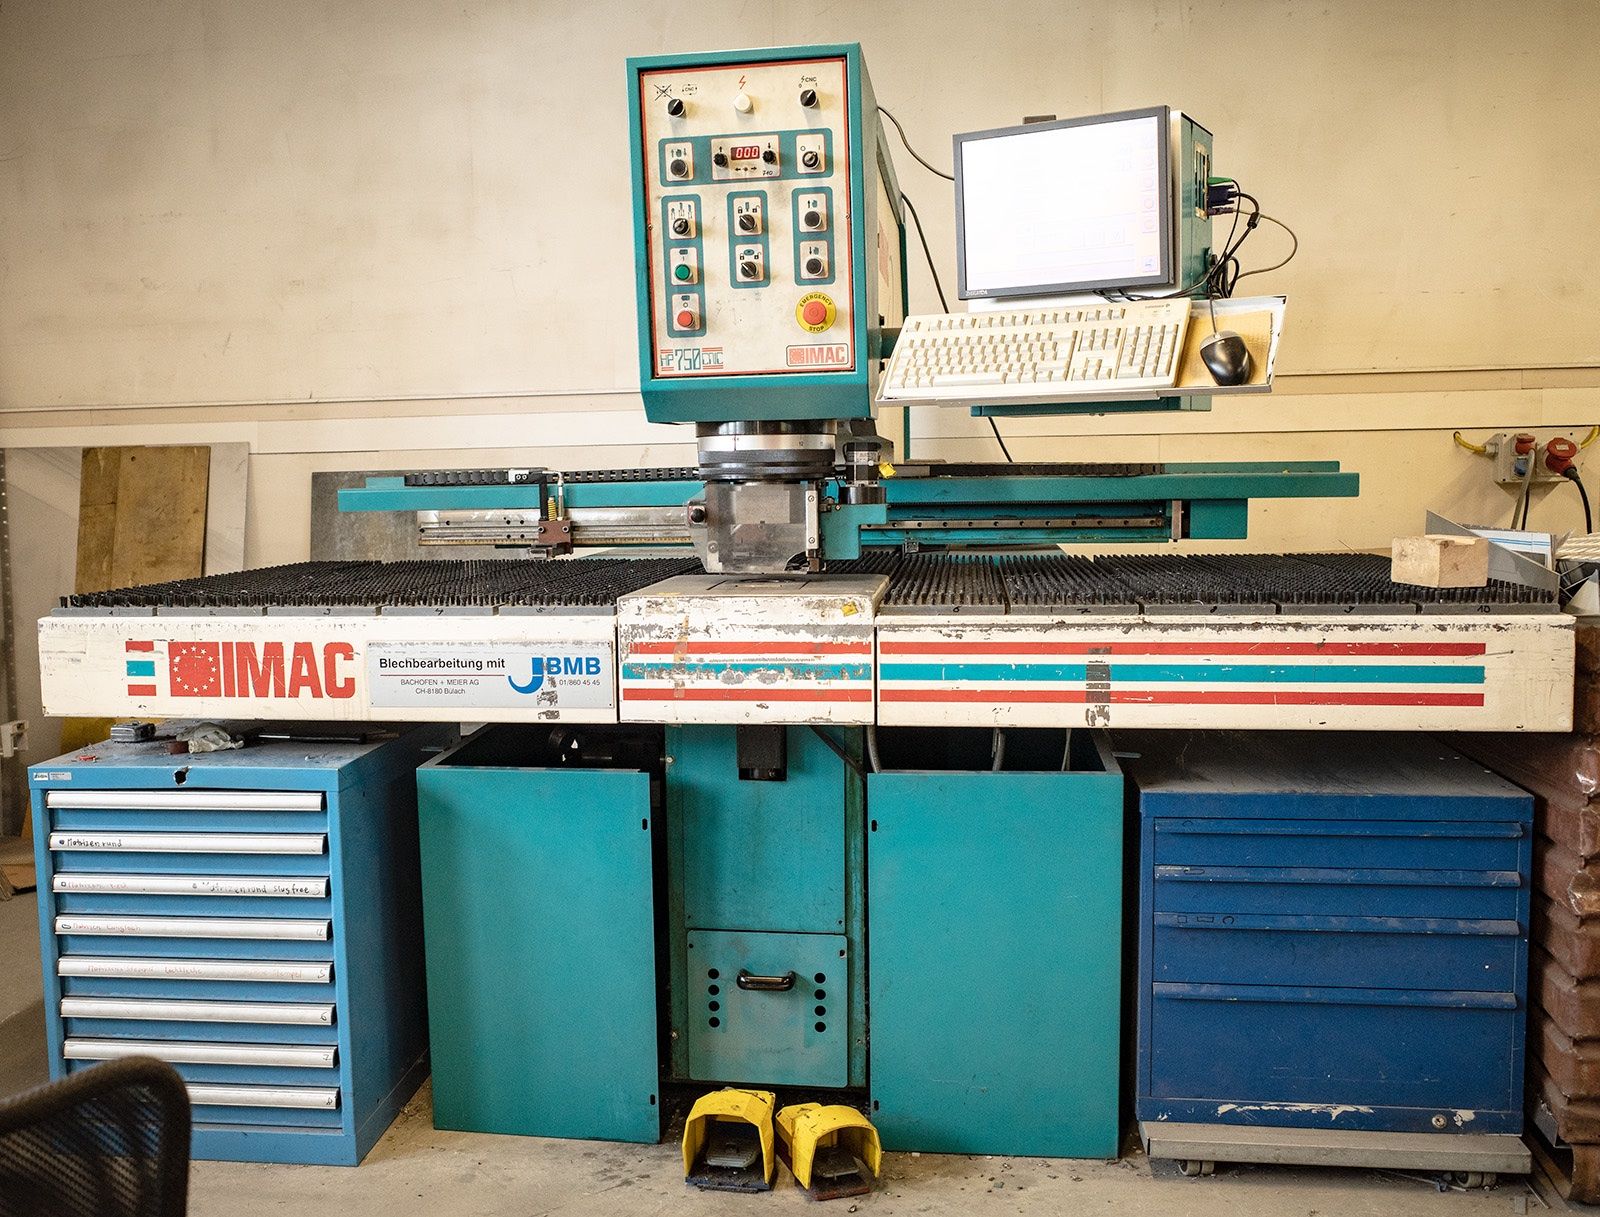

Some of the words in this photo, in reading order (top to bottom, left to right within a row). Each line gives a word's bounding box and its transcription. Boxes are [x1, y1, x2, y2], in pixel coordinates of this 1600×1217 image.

[736, 147, 759, 158] 000
[799, 294, 832, 308] EMERGENCY
[675, 348, 701, 371] 750
[805, 346, 845, 364] IMAC
[1477, 605, 1491, 613] 10
[221, 641, 356, 699] IMAC
[379, 658, 483, 670] Blechbearbeitung
[486, 658, 506, 668] mit
[546, 657, 601, 675] BMB
